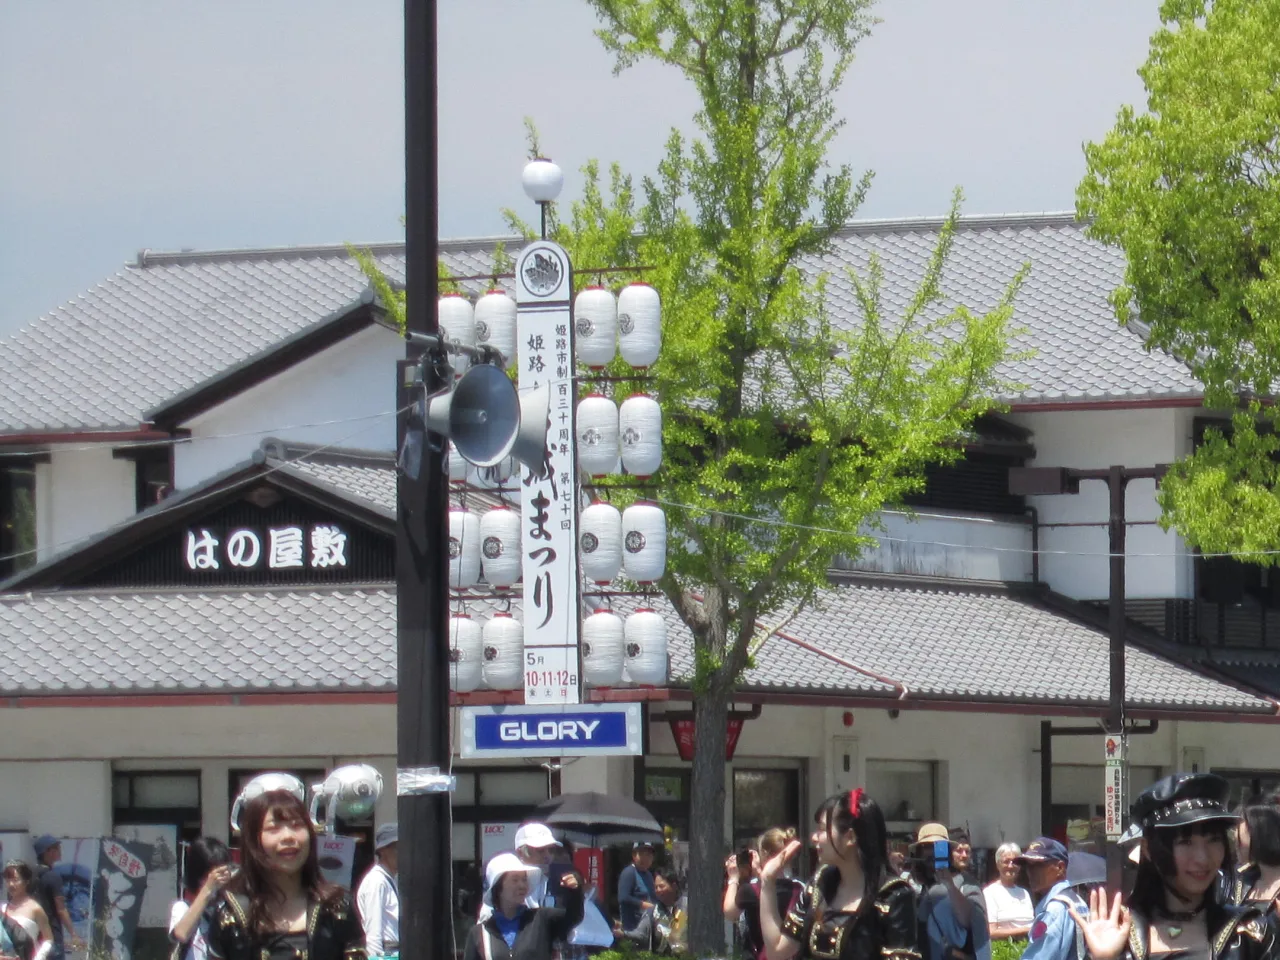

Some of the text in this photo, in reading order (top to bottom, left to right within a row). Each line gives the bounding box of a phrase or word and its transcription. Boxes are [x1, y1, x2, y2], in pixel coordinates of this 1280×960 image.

[527, 334, 546, 373] 姫路
[555, 324, 572, 530] 姫路市制百三十周年 第七十回
[186, 526, 348, 570] はの屋敷
[526, 652, 545, 666] 5月
[500, 720, 601, 741] GLORY
